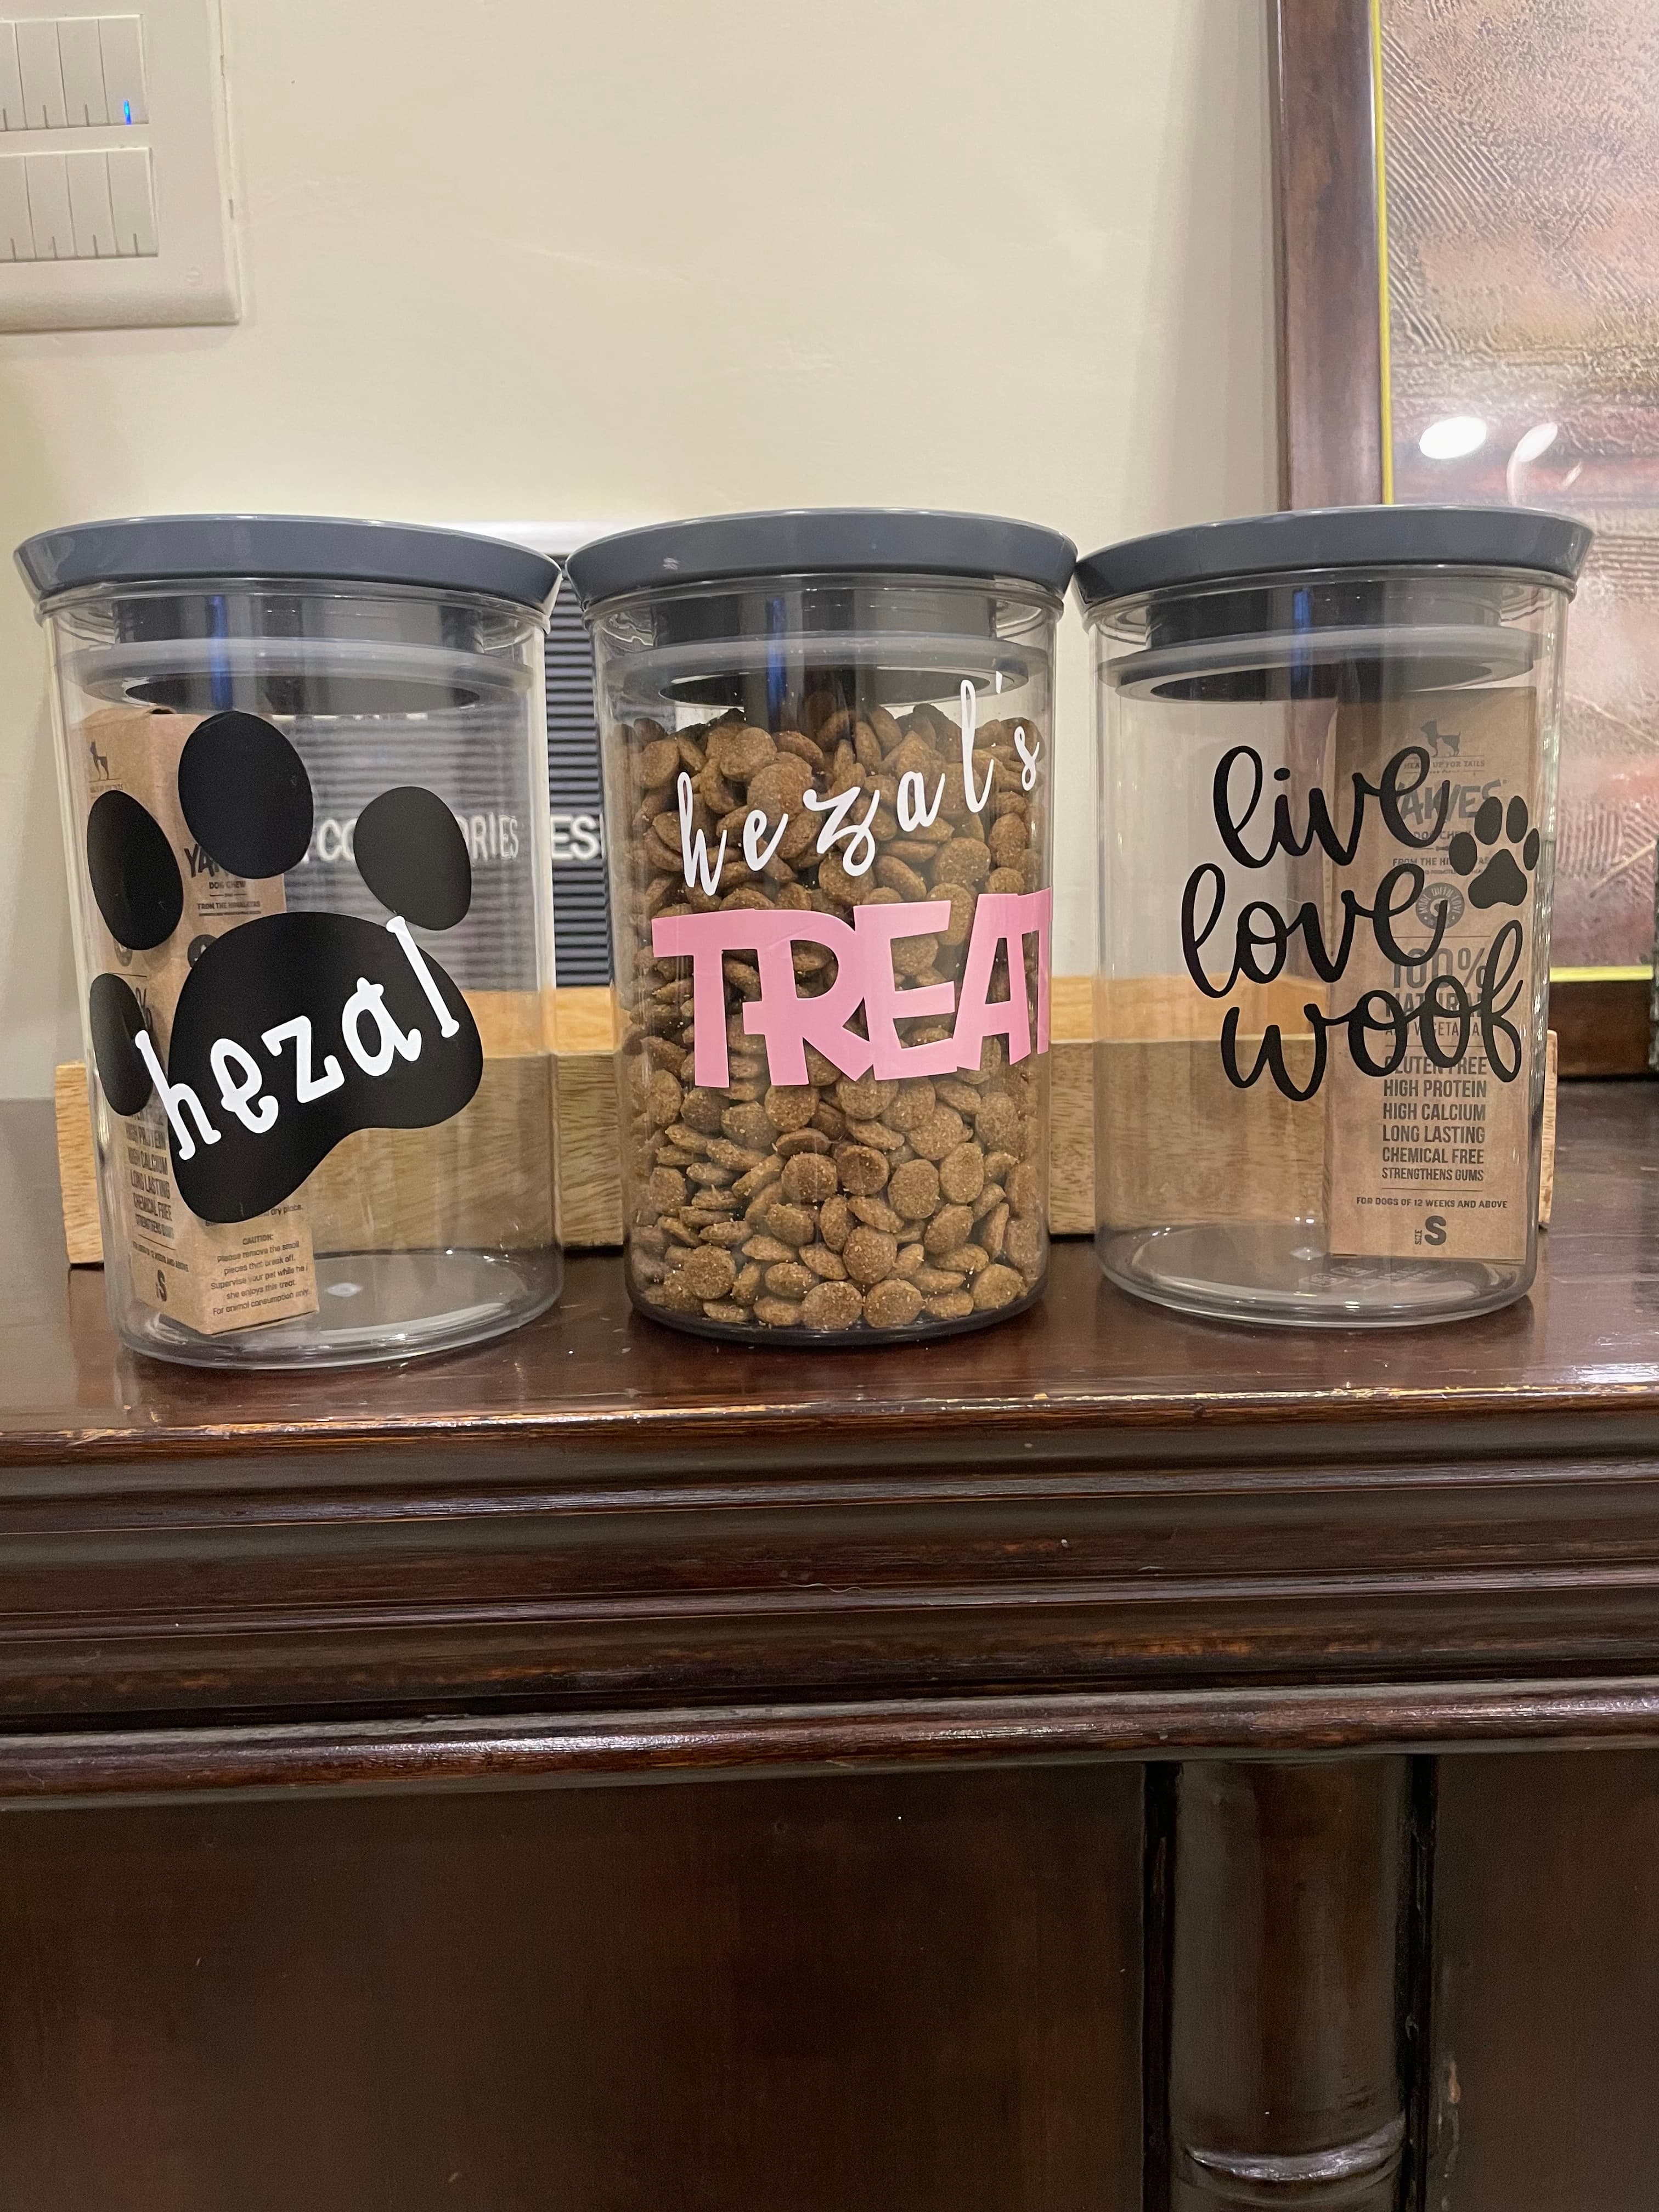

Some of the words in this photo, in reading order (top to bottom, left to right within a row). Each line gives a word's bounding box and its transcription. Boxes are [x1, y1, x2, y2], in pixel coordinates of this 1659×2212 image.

[1213, 746, 1450, 868] live
[1420, 857, 1437, 866] THE
[1181, 863, 1447, 998] love
[1220, 919, 1523, 1102] woof
[135, 916, 460, 1160] hezal
[1383, 1079, 1419, 1097] HIGH
[1423, 1080, 1487, 1098] PROTEIN
[1383, 1103, 1417, 1120] HIGH
[1421, 1103, 1486, 1121] CALCIUM
[1383, 1124, 1420, 1142] LONG
[1424, 1126, 1486, 1144] LASTING
[1382, 1147, 1448, 1163] CHEMICAL
[1452, 1148, 1485, 1164] FREE
[1381, 1167, 1453, 1181] STRENGTHENS
[1455, 1169, 1484, 1181] GUMS
[1356, 1197, 1373, 1205] FOR
[1375, 1197, 1399, 1206] DOGS
[1426, 1199, 1455, 1207] WEEKS
[1424, 1215, 1447, 1246] S
[269, 1245, 280, 1253] the
[224, 1263, 247, 1276] pieces
[211, 1278, 247, 1290] Supervise
[265, 1271, 276, 1279] pet
[227, 1291, 239, 1300] she
[241, 1286, 264, 1299] enjoys
[213, 1307, 224, 1316] For
[226, 1301, 250, 1312] animal
[251, 1291, 294, 1307] consumption
